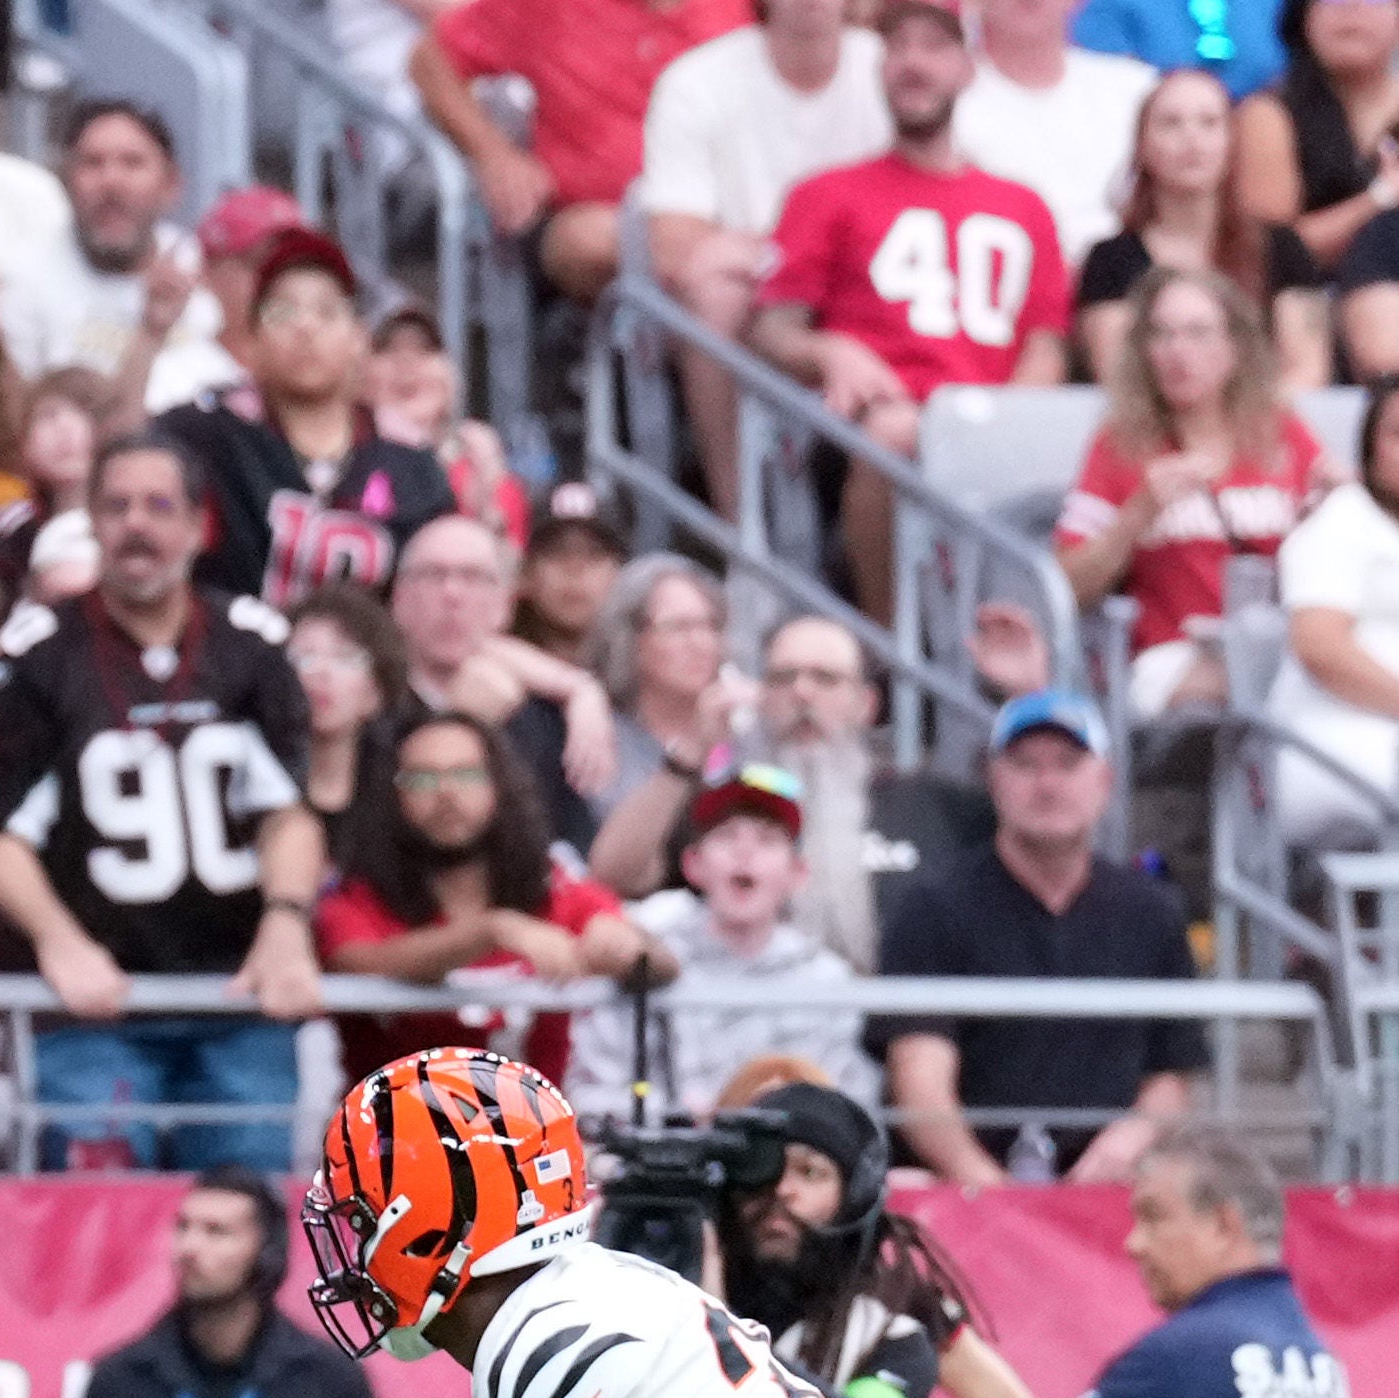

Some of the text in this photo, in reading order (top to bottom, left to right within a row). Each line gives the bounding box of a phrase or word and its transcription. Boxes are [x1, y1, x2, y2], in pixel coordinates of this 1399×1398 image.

[868, 207, 1035, 347] 40
[78, 722, 265, 904] 90
[531, 1221, 590, 1250] BENG
